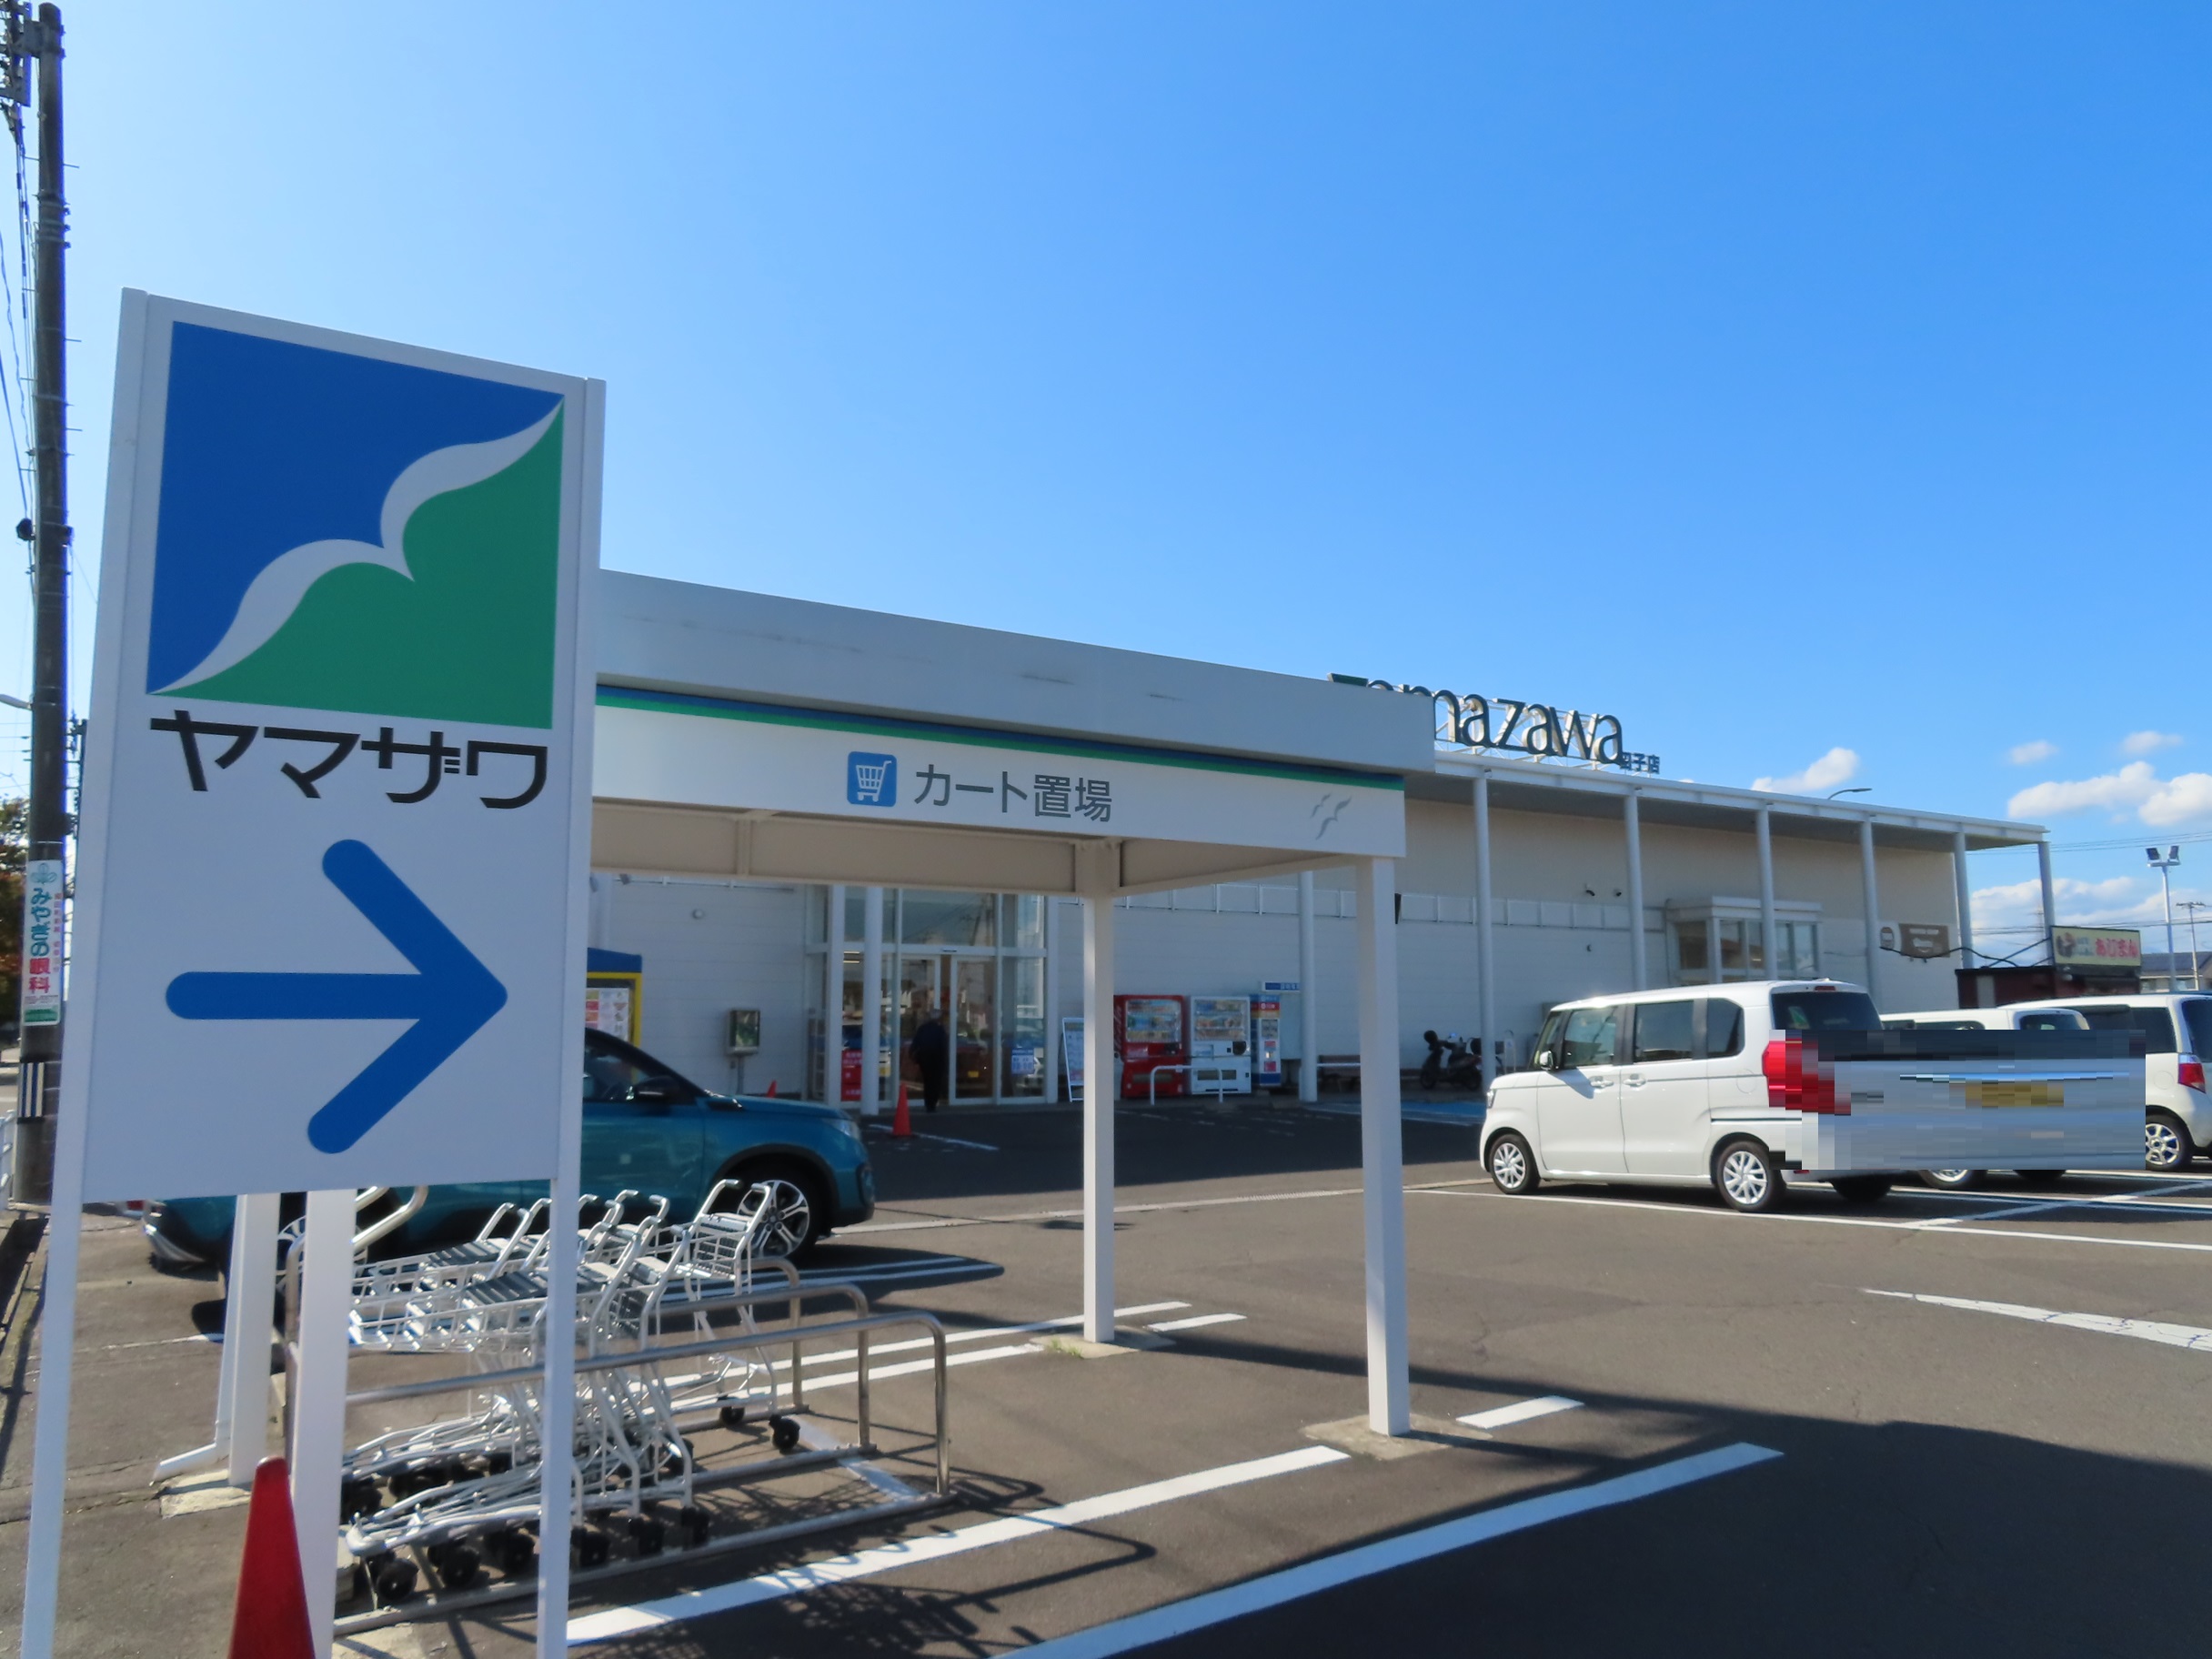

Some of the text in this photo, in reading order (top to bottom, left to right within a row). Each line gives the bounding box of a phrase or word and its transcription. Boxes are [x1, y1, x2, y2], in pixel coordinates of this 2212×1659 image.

[149, 709, 548, 809] ヤマザワ
[913, 763, 1112, 823] カート置場
